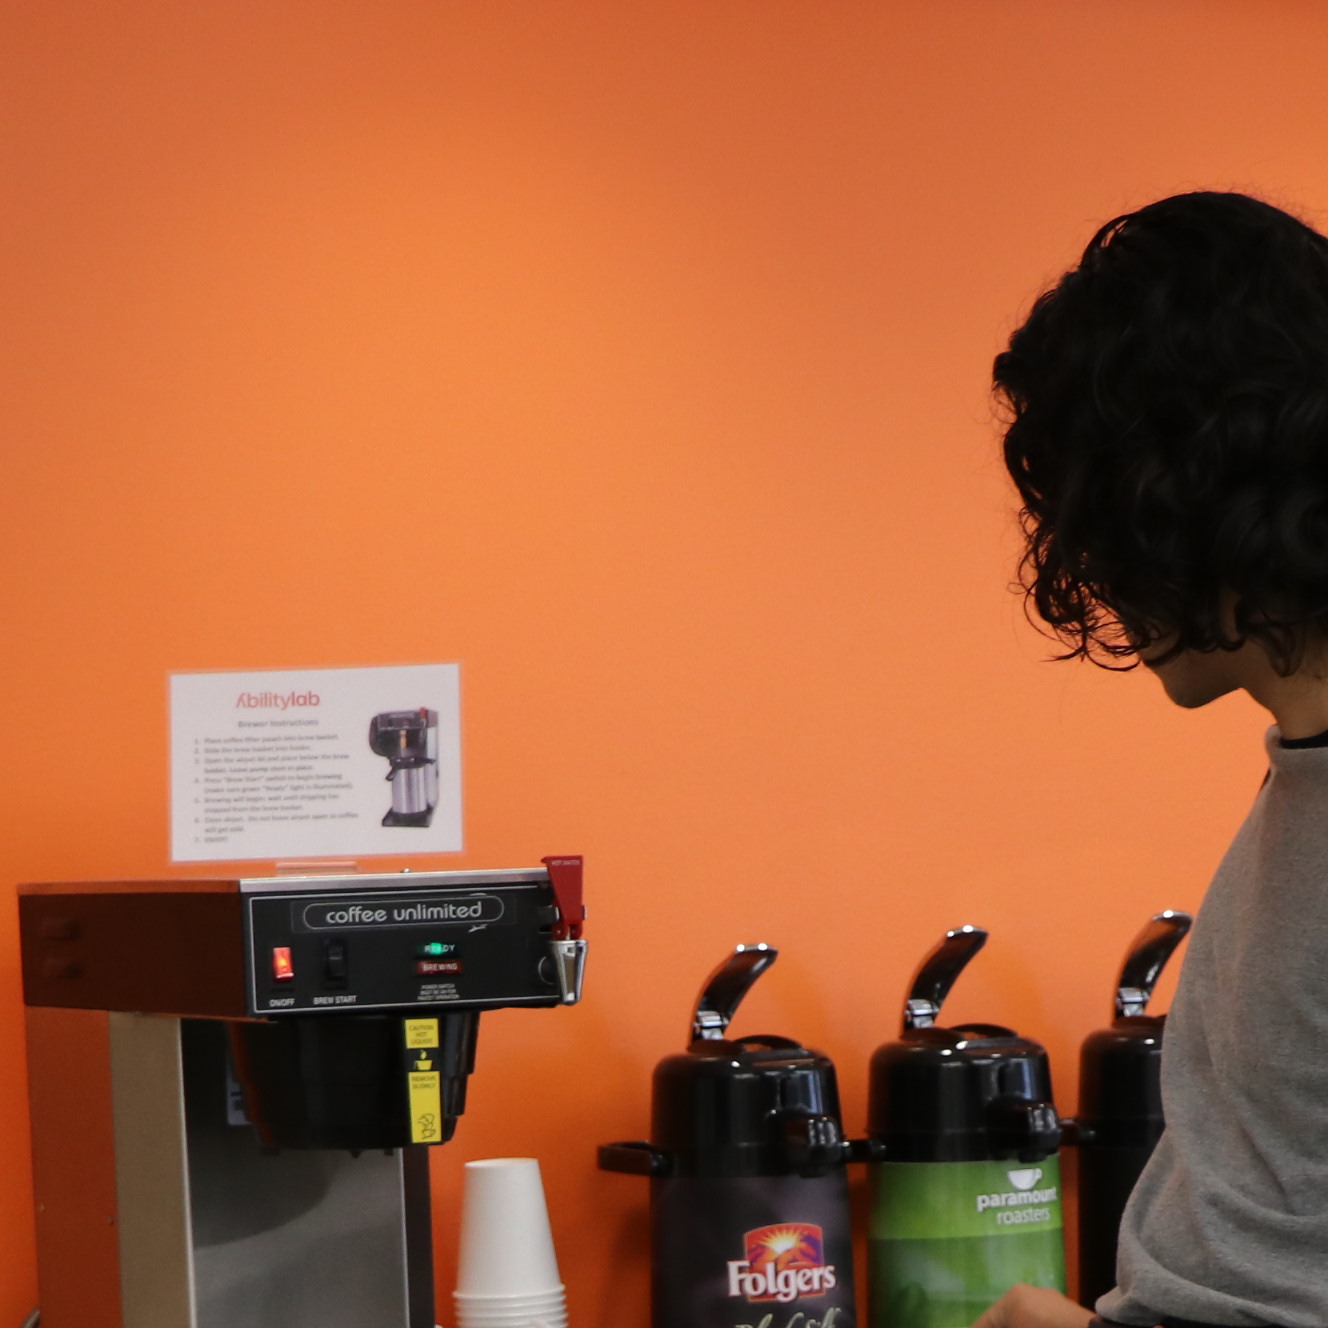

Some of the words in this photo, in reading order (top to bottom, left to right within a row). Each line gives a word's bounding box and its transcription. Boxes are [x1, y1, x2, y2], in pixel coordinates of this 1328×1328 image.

[235, 691, 321, 711] Abilitylab
[326, 906, 387, 924] coffee
[393, 901, 482, 921] unlimited
[424, 944, 455, 953] READY
[423, 962, 458, 972] BREWING
[313, 997, 334, 1006] BREW
[335, 995, 358, 1005] START
[976, 1187, 1056, 1212] paramount
[997, 1208, 1051, 1225] roasters
[728, 1260, 836, 1301] Folgers
